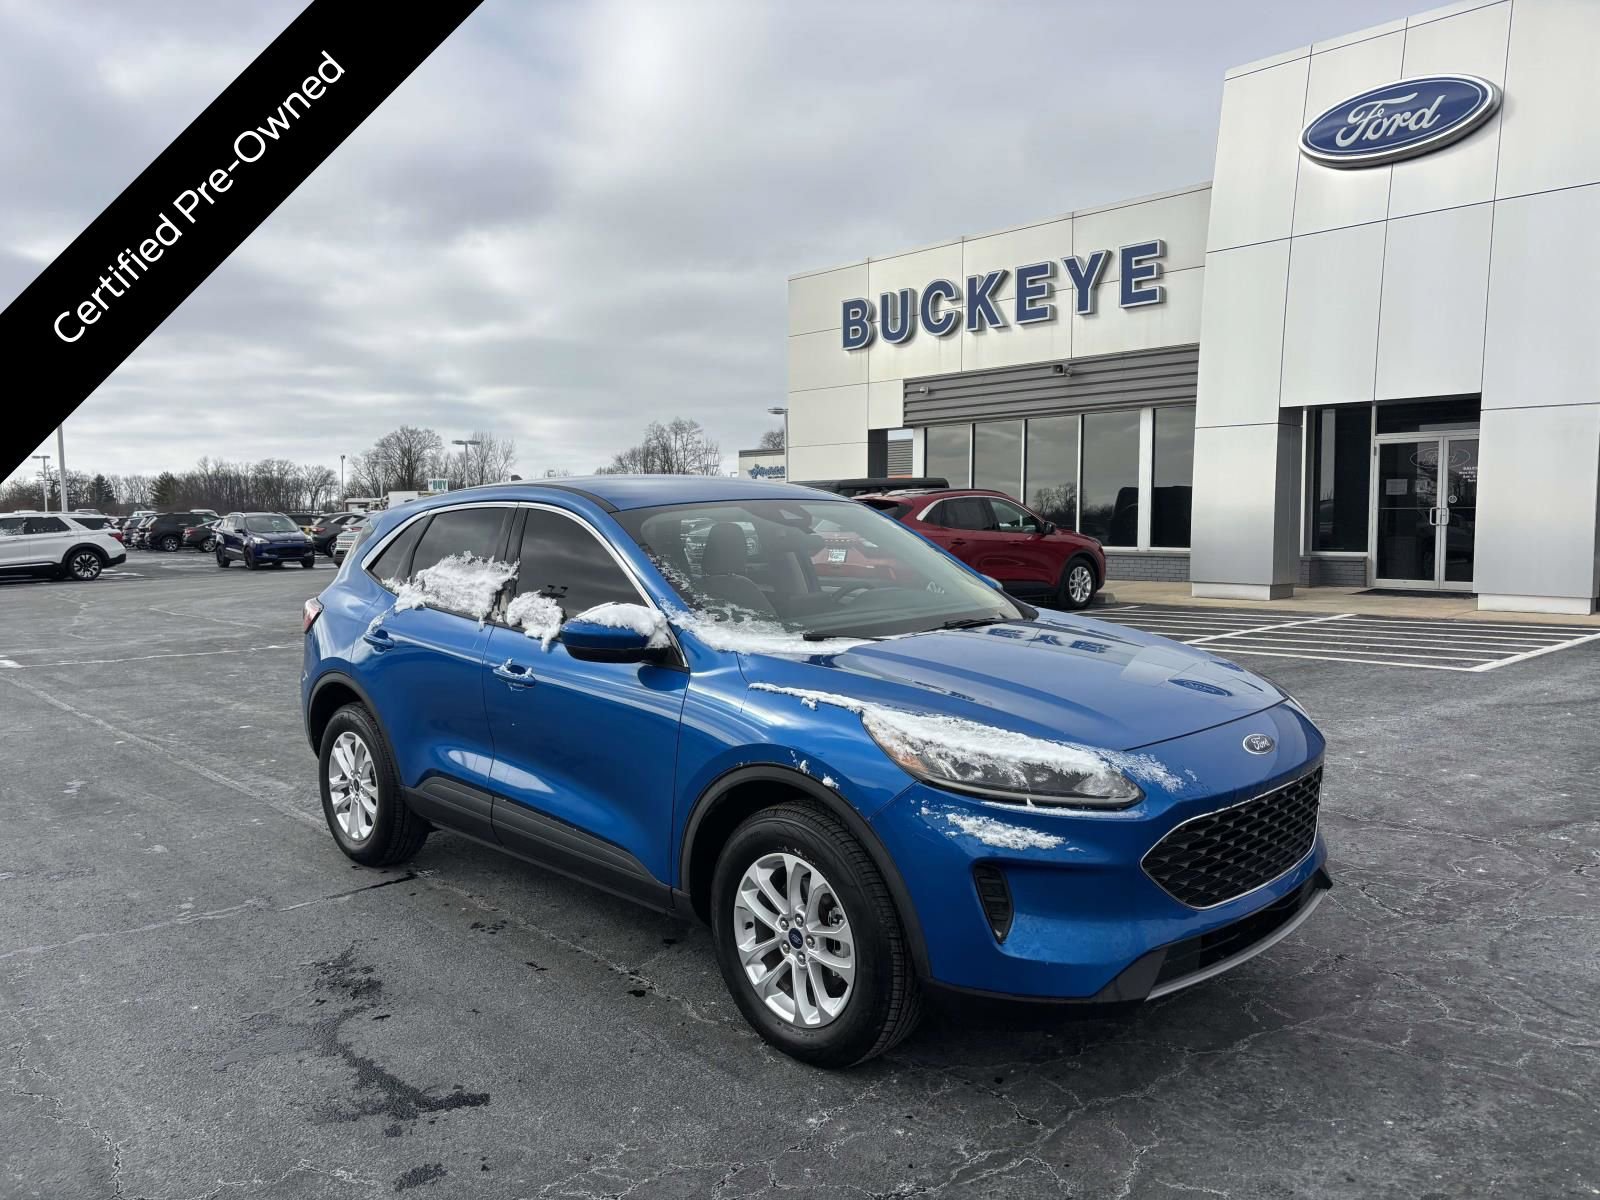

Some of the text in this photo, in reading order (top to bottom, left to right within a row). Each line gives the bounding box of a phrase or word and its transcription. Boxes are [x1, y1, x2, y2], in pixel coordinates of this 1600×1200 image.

[1335, 92, 1447, 148] Ford
[840, 239, 1167, 352] BUCKEYE
[1250, 736, 1271, 751] Ford
